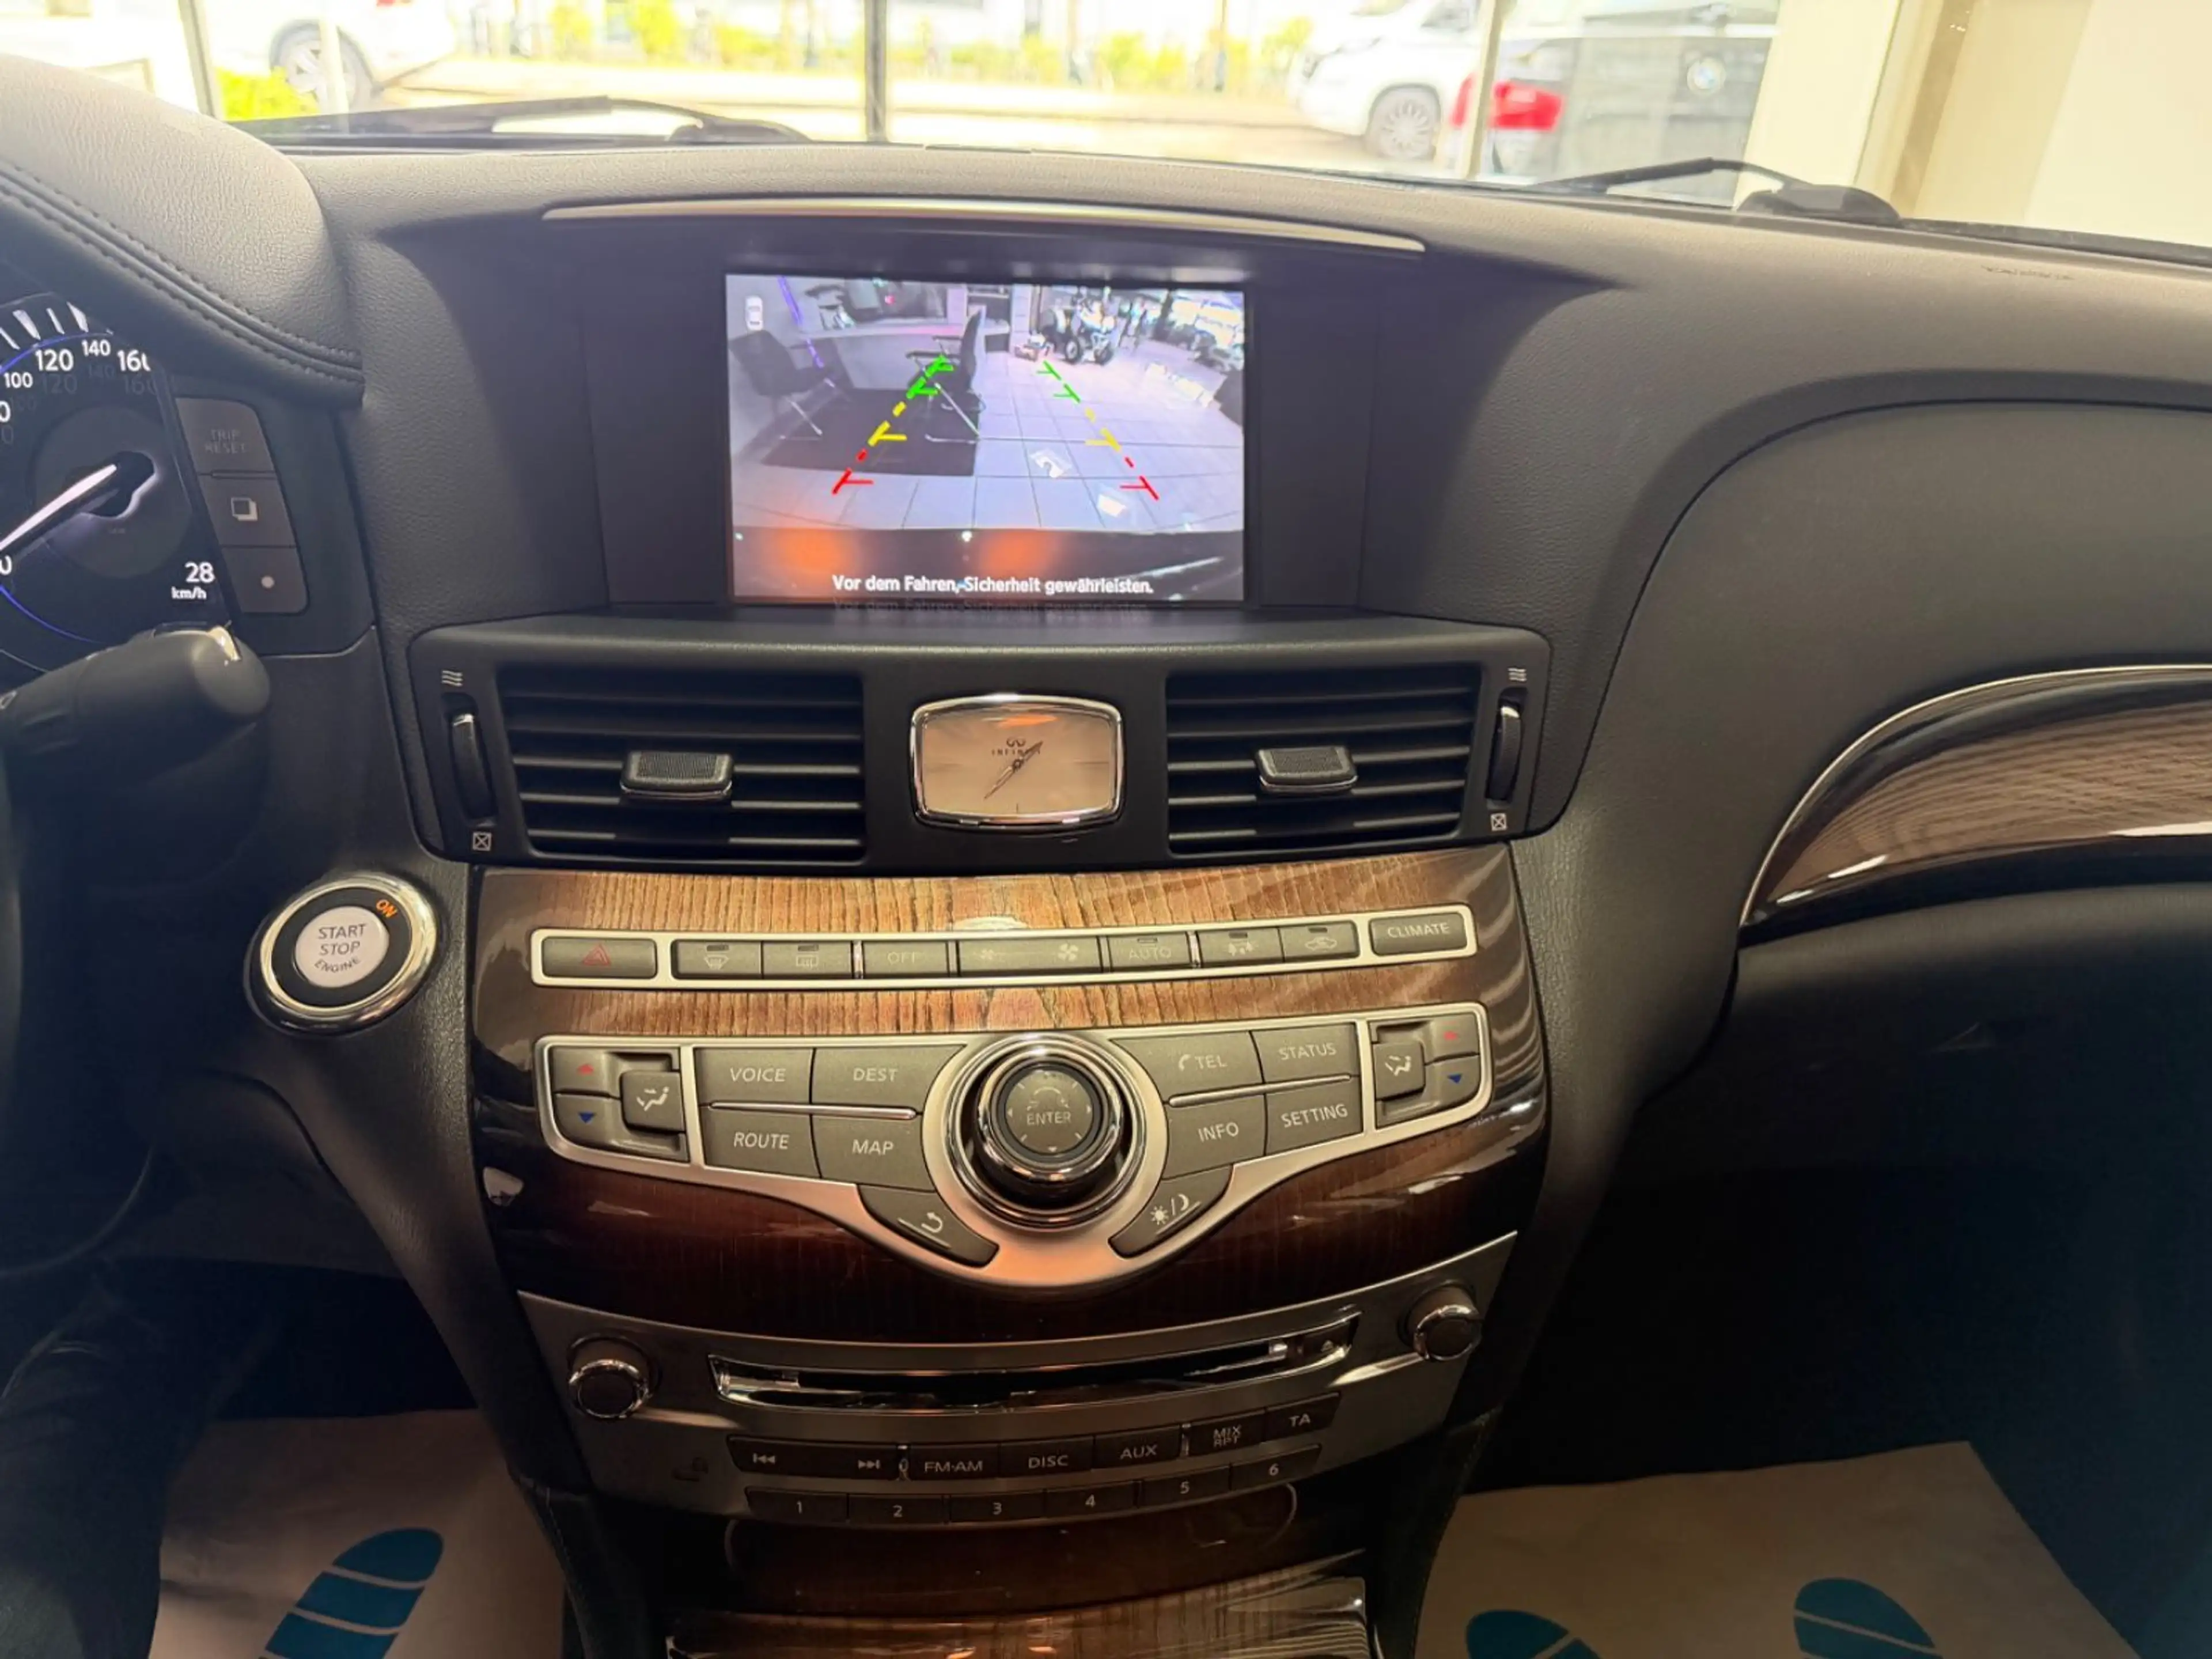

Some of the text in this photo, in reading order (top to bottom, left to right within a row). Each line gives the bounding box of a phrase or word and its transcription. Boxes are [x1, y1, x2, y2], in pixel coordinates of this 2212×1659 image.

[82, 339, 111, 356] 140
[35, 349, 74, 371] 120
[4, 372, 33, 388] 100
[185, 561, 215, 583] 28
[832, 575, 861, 592] Vor
[866, 575, 900, 592] dem
[904, 576, 960, 594] Fahren,
[964, 576, 1041, 593] Sicherheit
[172, 586, 206, 600] km/h
[376, 899, 397, 918] ON
[319, 923, 367, 939] START
[1387, 921, 1450, 938] CLIMATE
[319, 941, 361, 956] STOP
[1128, 945, 1172, 960] AUTO
[888, 950, 920, 964] OFF
[314, 957, 361, 973] ENGINE
[1278, 1042, 1337, 1058] STATUS
[1195, 1054, 1227, 1069] TEL
[729, 1067, 786, 1083] VOICE
[853, 1067, 899, 1082] DEST
[1027, 1111, 1072, 1126] ENTER
[1281, 1103, 1349, 1127] SETTING
[1197, 1121, 1239, 1142] INFO
[733, 1132, 789, 1150] ROUTE
[852, 1139, 893, 1156] MAP
[1288, 1413, 1311, 1427] TA
[1213, 1425, 1241, 1440] MIX
[1120, 1445, 1157, 1460] AUX
[1028, 1455, 1069, 1469] DISC
[1270, 1462, 1279, 1477] 6
[1180, 1480, 1190, 1495] 5
[797, 1502, 802, 1514] 1
[1085, 1494, 1096, 1508] 4
[893, 1505, 903, 1518] 2
[993, 1502, 1002, 1516] 3
